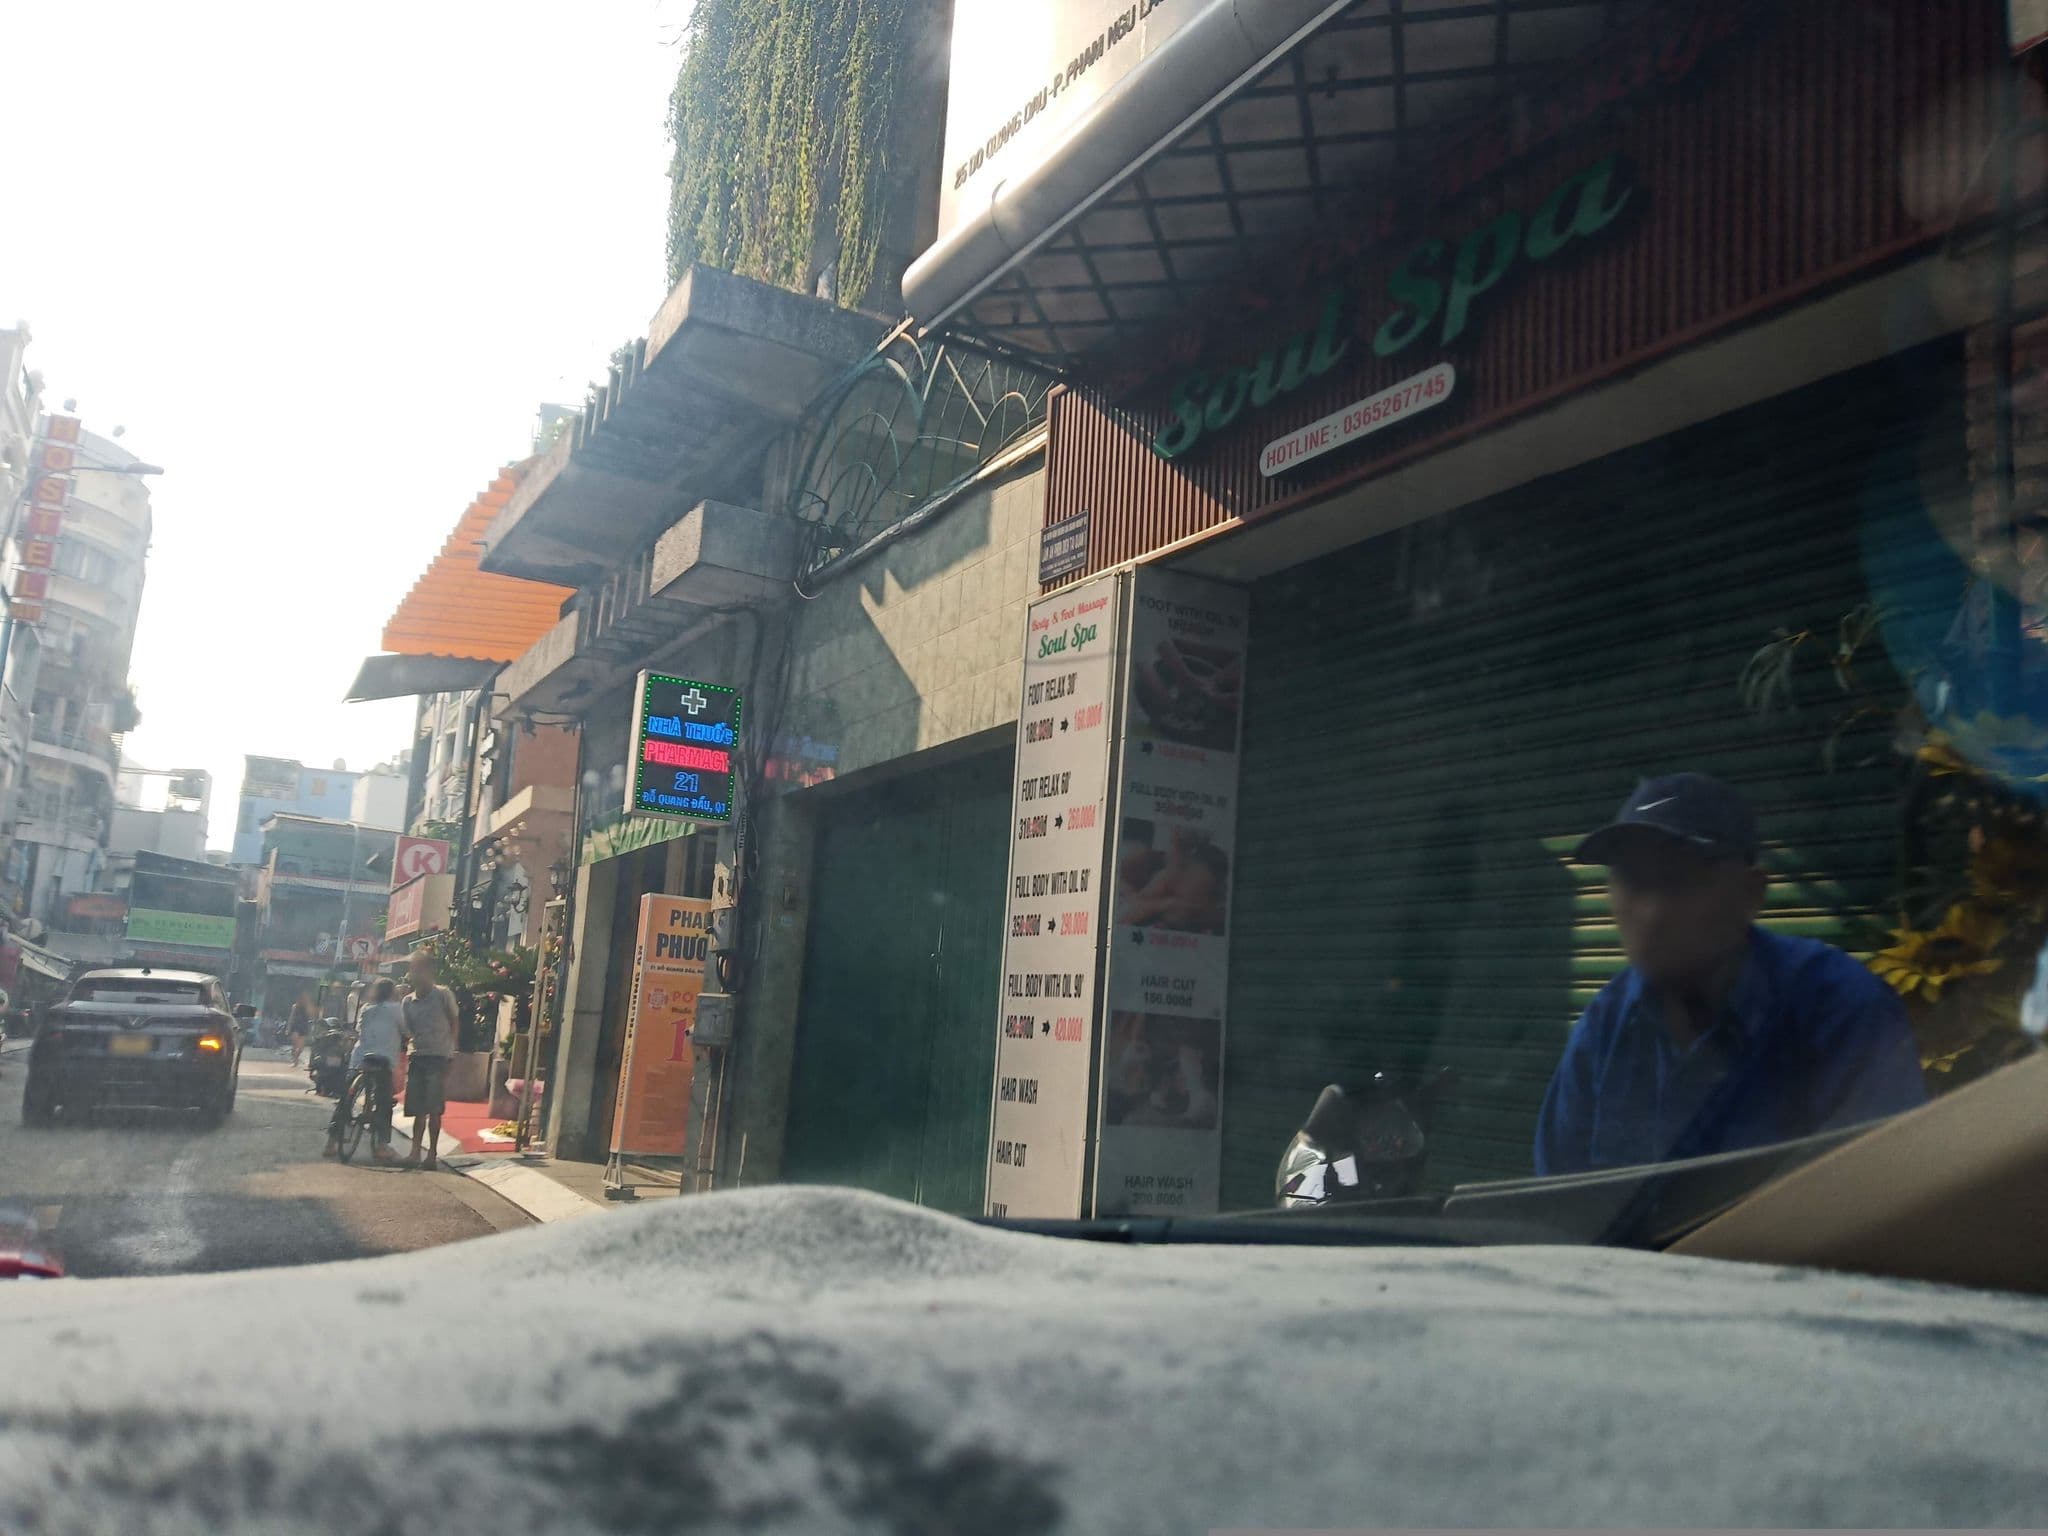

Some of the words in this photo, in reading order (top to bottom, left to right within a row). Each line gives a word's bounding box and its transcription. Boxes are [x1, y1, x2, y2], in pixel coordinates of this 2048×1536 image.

[986, 111, 1022, 160] QUANG
[1373, 153, 1634, 358] Spa
[1344, 373, 1446, 434] 0365267745
[1038, 629, 1067, 658] Soul
[1071, 623, 1097, 652] Spa
[1027, 682, 1044, 706] FOOT
[1045, 675, 1066, 701] RELAX
[648, 715, 681, 737] NHÀ
[685, 722, 733, 745] THUỐC
[673, 771, 699, 793] 21
[1021, 778, 1038, 802] FOOT
[1039, 773, 1060, 799] RELAX
[658, 794, 690, 808] QUANG
[412, 851, 436, 874] K
[1015, 875, 1030, 898] FULL
[1032, 873, 1050, 896] BODY
[1051, 871, 1068, 895] WITH
[1008, 974, 1023, 997] FULL
[1025, 973, 1043, 997] BODY
[1044, 973, 1061, 998] WITH
[1140, 975, 1168, 988] HAIR
[1172, 977, 1197, 992] CUT
[1000, 1076, 1017, 1102] HAIR
[1018, 1077, 1039, 1104] WASH
[996, 1139, 1013, 1165] HAIR
[1014, 1142, 1027, 1168] CUT
[1124, 1175, 1154, 1188] HAIR
[1157, 1176, 1193, 1189] WASH
